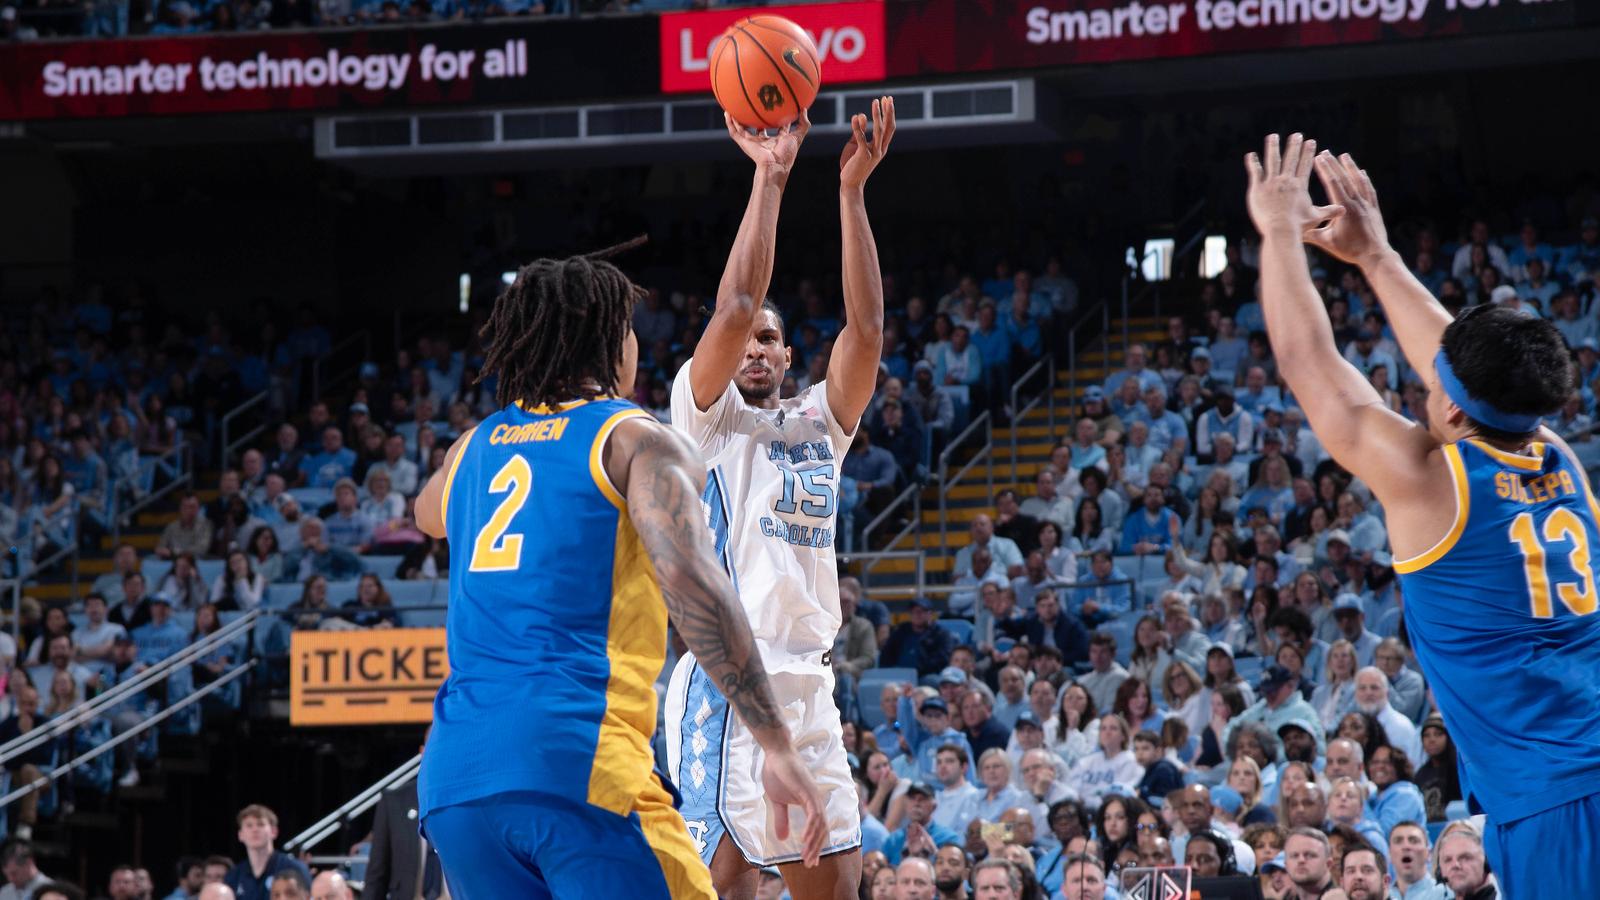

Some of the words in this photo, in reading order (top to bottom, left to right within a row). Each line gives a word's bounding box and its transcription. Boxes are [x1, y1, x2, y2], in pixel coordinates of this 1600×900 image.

[1026, 6, 1183, 44] Smarter
[1195, 0, 1429, 31] technology
[42, 60, 192, 96] Smarter
[199, 49, 411, 90] technology
[419, 44, 475, 80] for
[482, 40, 528, 77] all
[769, 440, 834, 464] NRTH
[469, 454, 533, 572] 2
[775, 463, 835, 518] 15
[1508, 506, 1599, 619] 13
